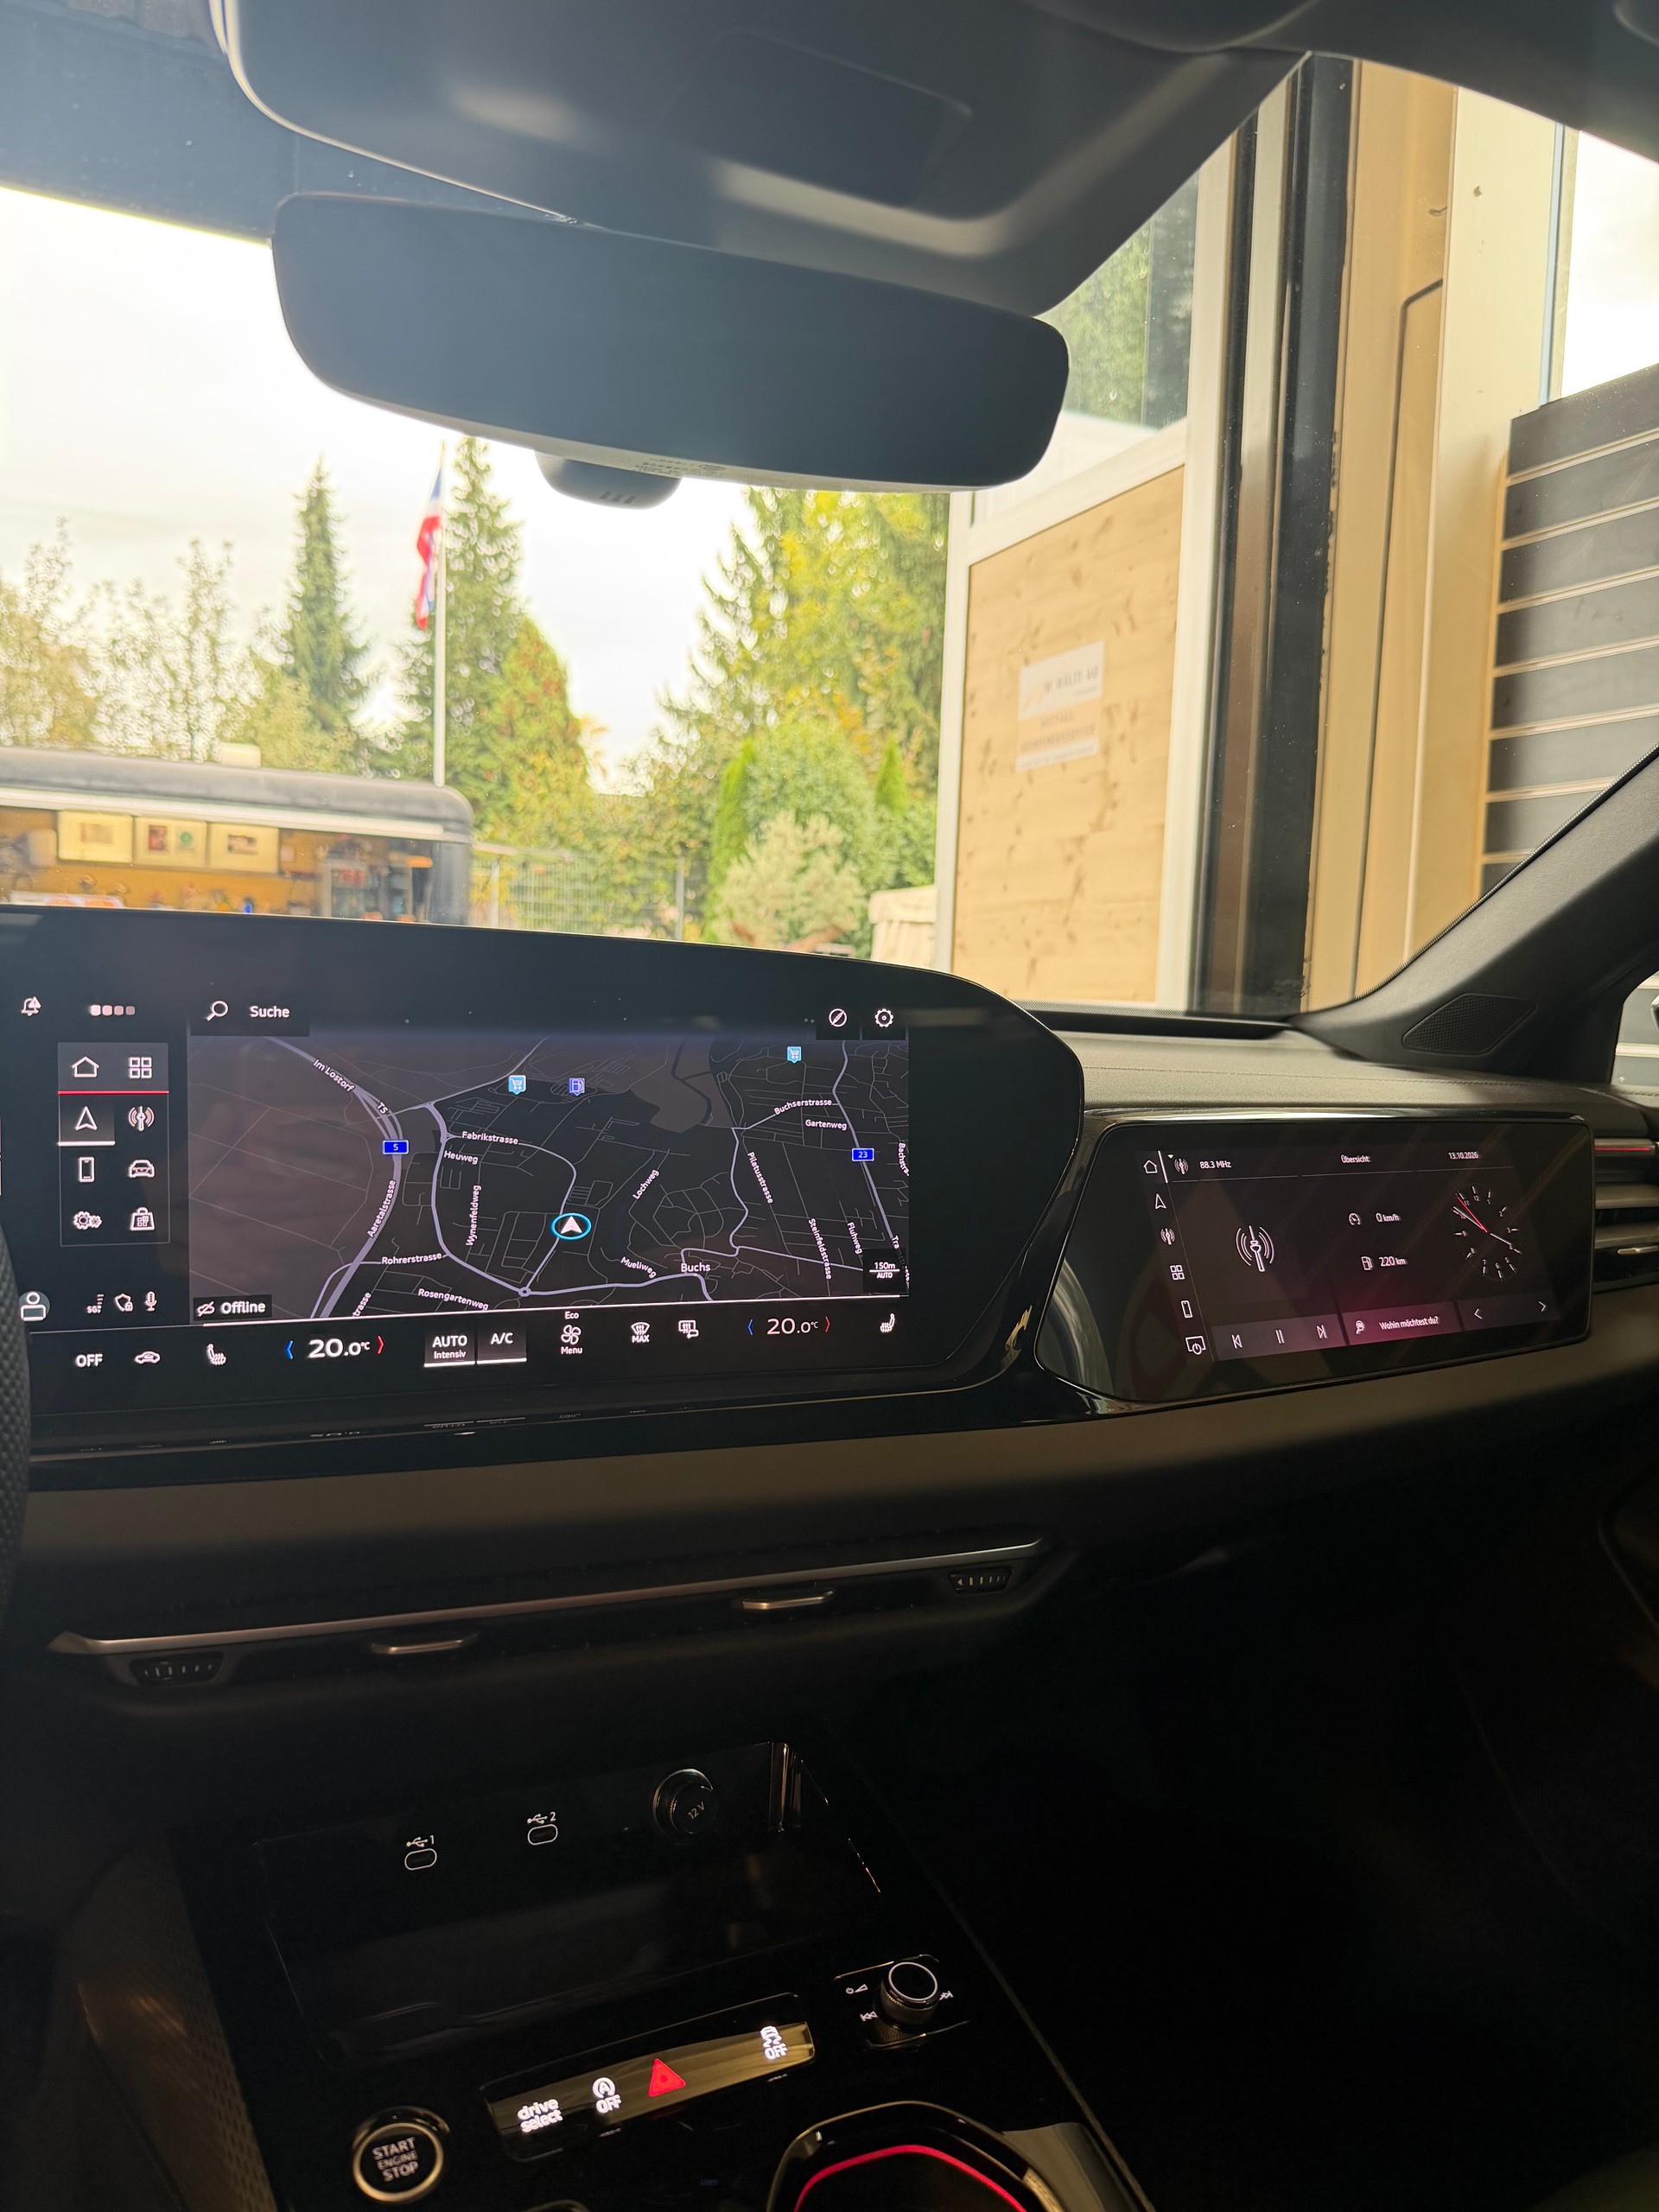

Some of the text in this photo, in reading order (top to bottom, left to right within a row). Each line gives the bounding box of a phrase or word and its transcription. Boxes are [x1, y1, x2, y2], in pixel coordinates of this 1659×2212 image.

[250, 1005, 290, 1018] Suche
[313, 1059, 355, 1092] Im Lostorf
[773, 1099, 832, 1115] Buchserstrasse
[805, 1119, 848, 1131] Gartenweg
[461, 1131, 518, 1145] Fabrikstrasse
[443, 1150, 479, 1165] Heuweg
[1341, 1154, 1370, 1164] Übersicht
[1448, 1151, 1478, 1160] 13.10.2026
[1199, 1160, 1231, 1169] 88.3 MHz
[632, 1169, 659, 1199] Lochweg
[747, 1152, 773, 1204] Pilatusstrasse
[367, 1179, 396, 1238] Aaretalstrasse
[466, 1185, 482, 1246] Wynenfeldweg
[1376, 1212, 1401, 1223] 0 km/h
[847, 1222, 863, 1255] Fluhweg
[808, 1218, 832, 1280] Steinfeldstrasse
[382, 1253, 442, 1265] Rohrerstrasse
[874, 1262, 896, 1270] 150m
[1379, 1256, 1407, 1267] 220 km
[620, 1256, 658, 1279] Mueliweg
[681, 1262, 711, 1272] Buchs
[418, 1288, 489, 1311] Rosengartenweg
[220, 1301, 266, 1314] Offline
[564, 1311, 579, 1320] Eco
[1379, 1315, 1440, 1331] Wohin möchtest du?
[433, 1335, 467, 1348] AUTO
[490, 1332, 513, 1345] A/C
[632, 1335, 650, 1344] MAX
[434, 1350, 467, 1359] Intensiv
[561, 1345, 583, 1355] Menu
[75, 1353, 103, 1368] OFF
[550, 1811, 556, 1821] 2
[687, 1801, 705, 1819] 12 V
[429, 1835, 435, 1845] 1
[764, 2043, 788, 2060] OFF
[517, 2098, 560, 2120] drive
[596, 2094, 622, 2114] OFF
[520, 2109, 563, 2133] select
[371, 2137, 416, 2160] START
[376, 2149, 419, 2171] ENGINE
[381, 2161, 420, 2182] STOP
